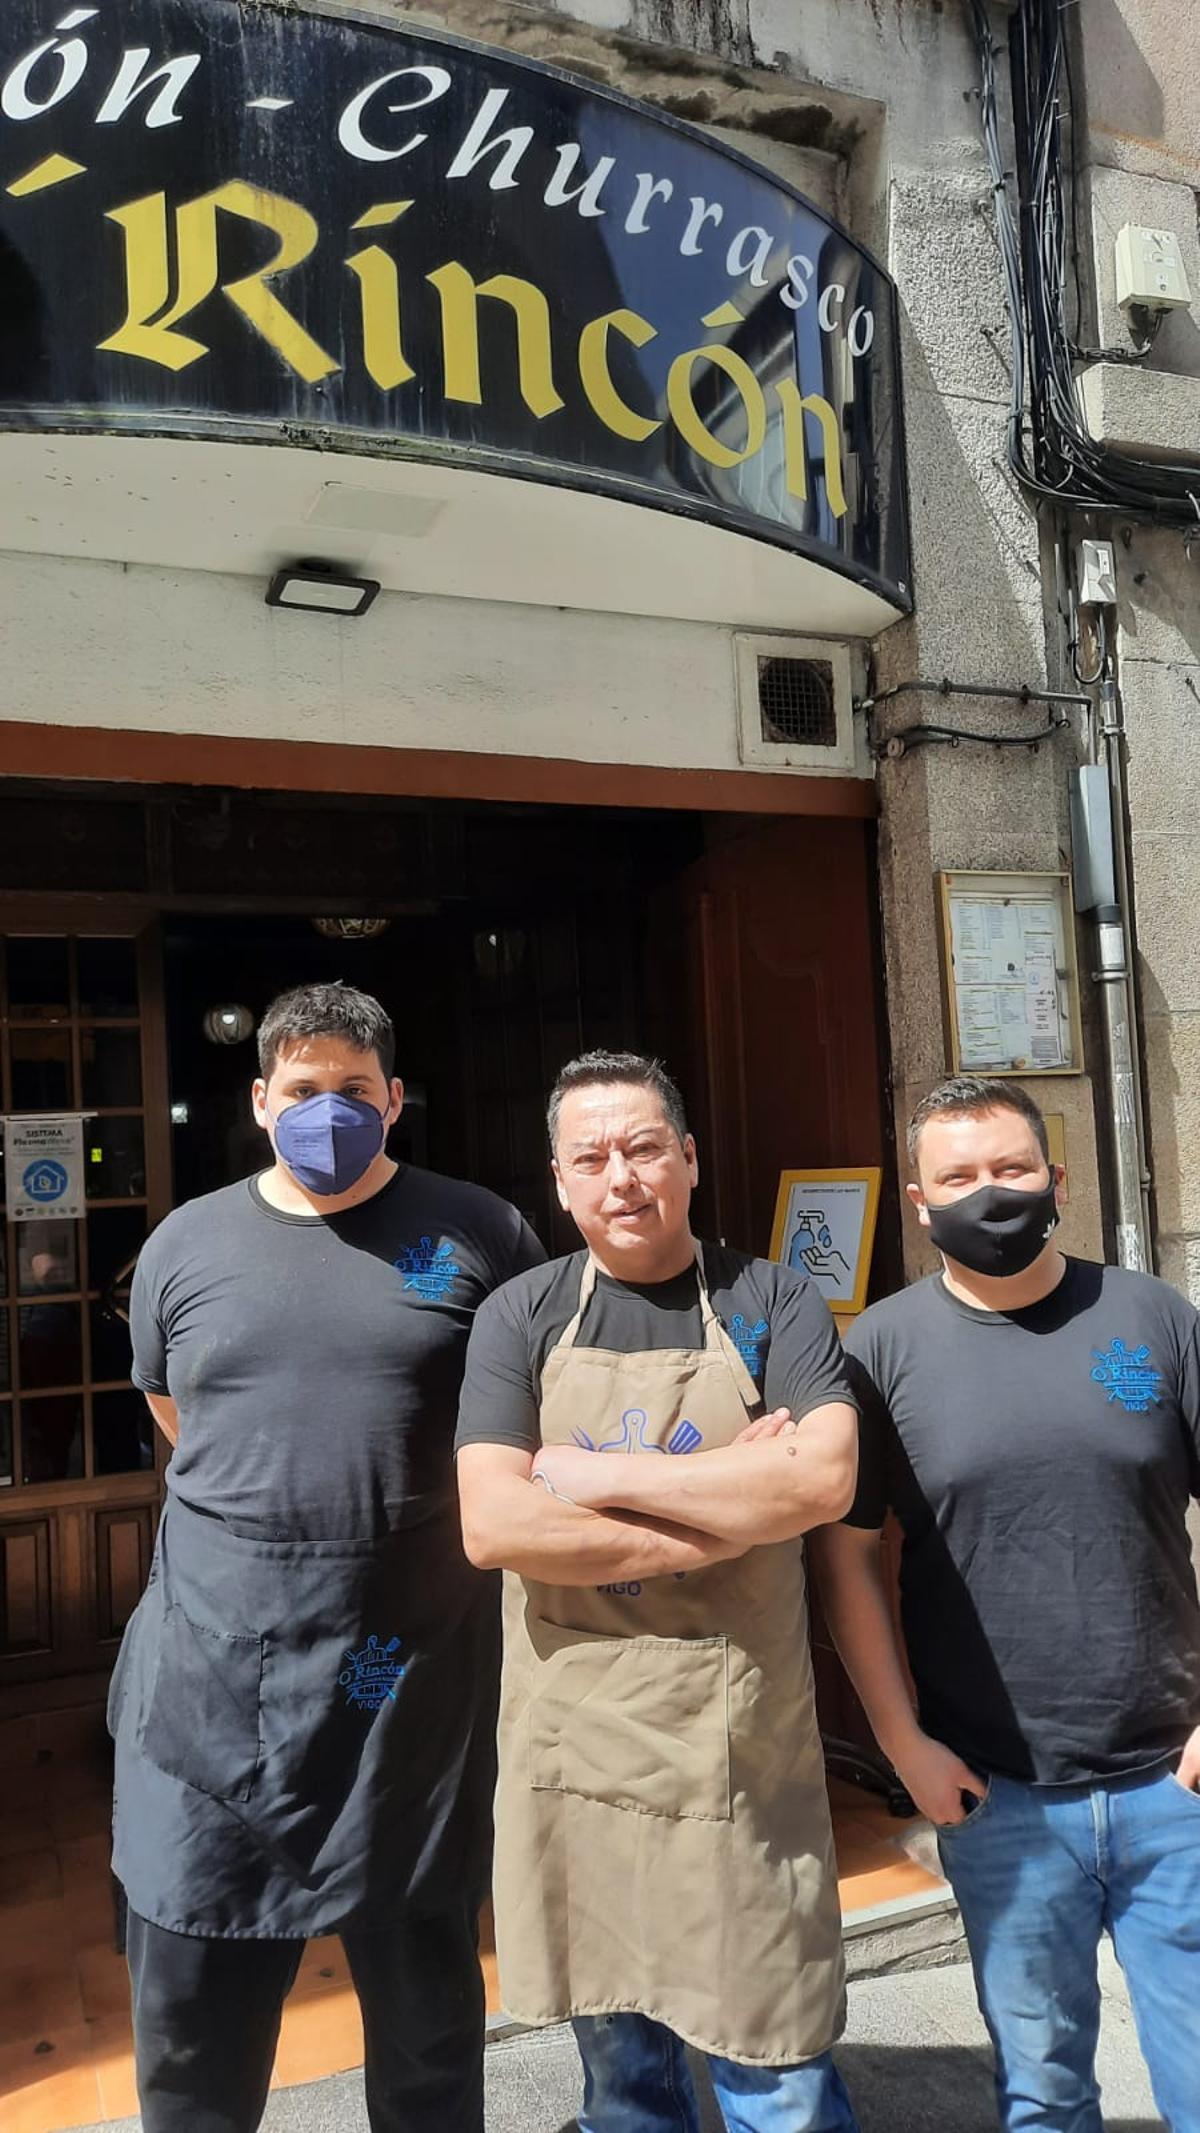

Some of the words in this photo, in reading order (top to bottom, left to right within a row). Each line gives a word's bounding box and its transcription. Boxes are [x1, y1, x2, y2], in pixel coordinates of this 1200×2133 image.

[338, 64, 874, 357] Churrasco
[338, 1671, 351, 1686] O
[353, 1661, 405, 1681] Rincón
